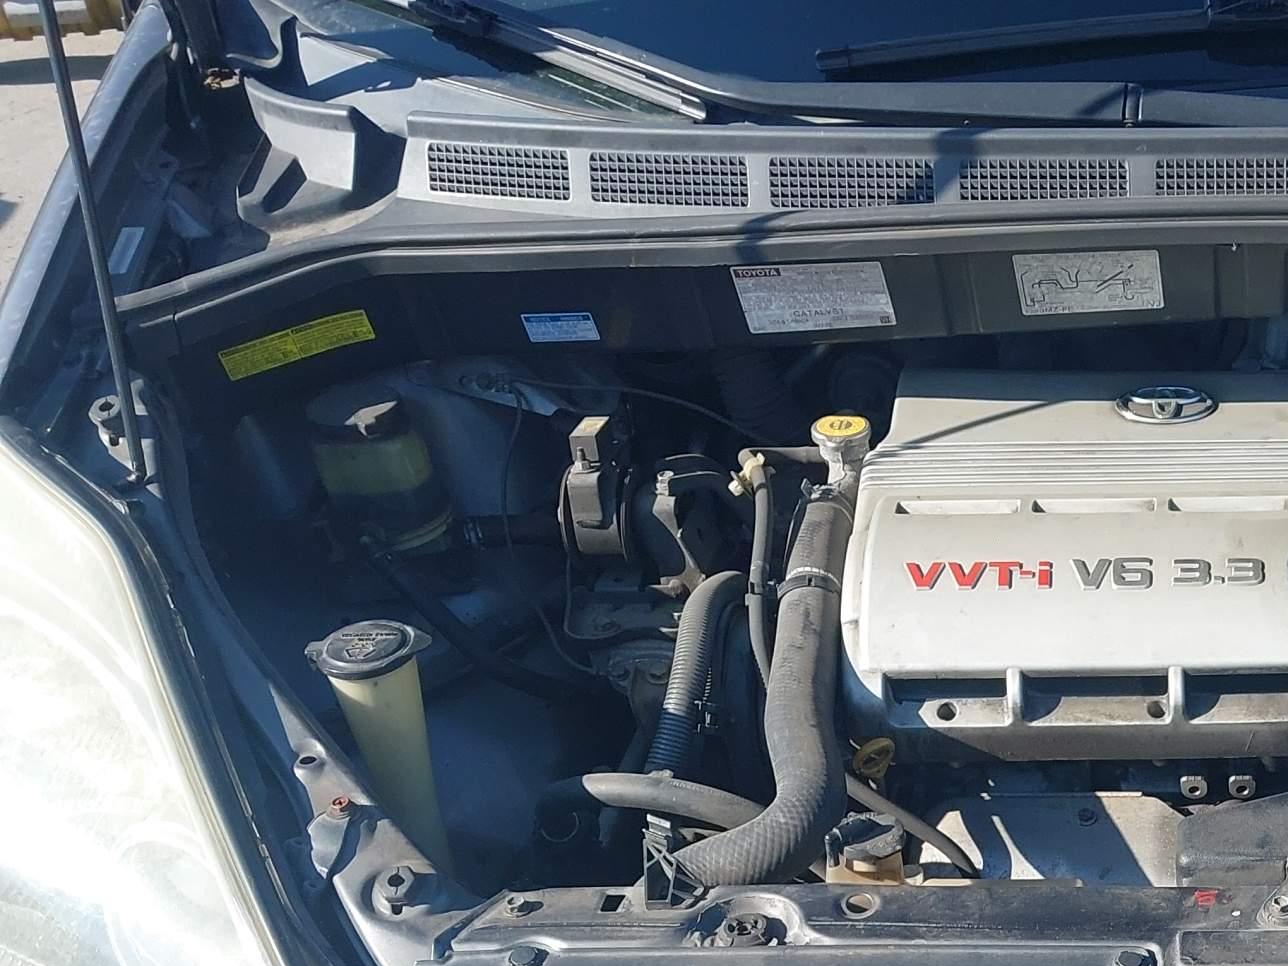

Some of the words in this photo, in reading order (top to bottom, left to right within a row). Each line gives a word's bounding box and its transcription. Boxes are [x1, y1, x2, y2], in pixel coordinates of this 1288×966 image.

[737, 268, 779, 278] TOYOTA
[793, 308, 844, 318] CATALYST
[904, 559, 1054, 590] VVT-i
[1072, 557, 1153, 590] V6
[1170, 557, 1265, 587] 3.3
